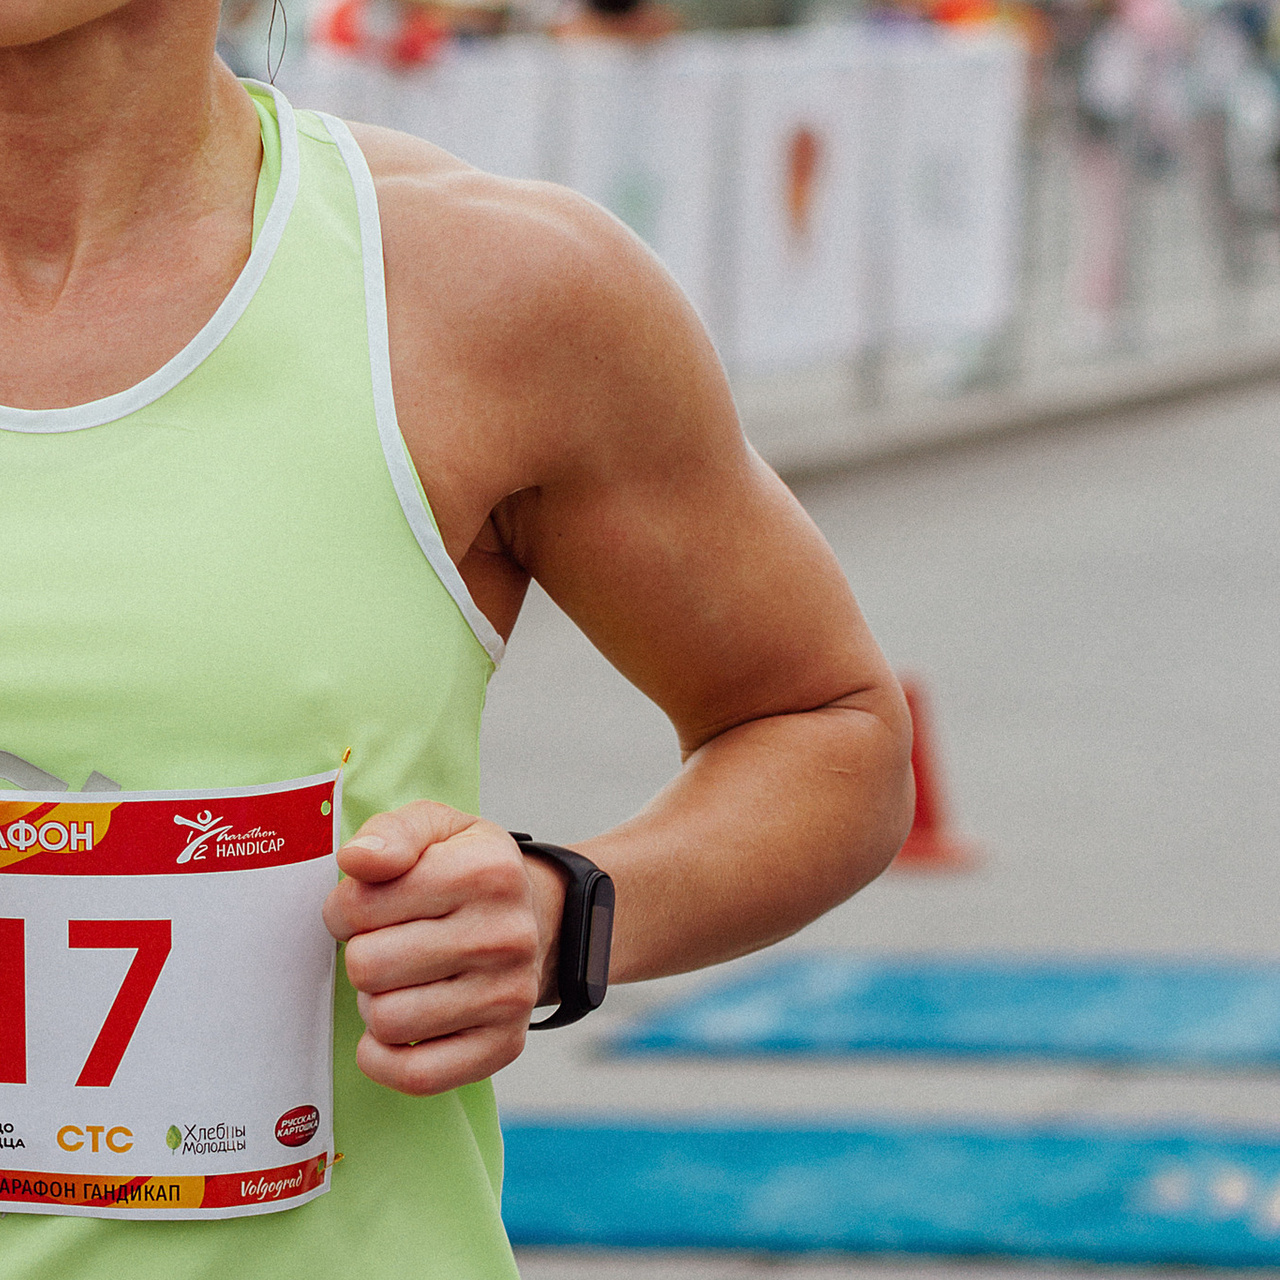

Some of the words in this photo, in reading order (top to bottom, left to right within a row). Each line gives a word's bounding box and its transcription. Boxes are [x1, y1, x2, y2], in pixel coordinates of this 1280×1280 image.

[216, 837, 286, 858] HANDICAP
[281, 1111, 317, 1129] РУССКАЯ
[56, 1124, 134, 1154] СТС
[83, 1183, 181, 1205] ГАНДИКАП
[240, 1169, 303, 1200] Volgograd
